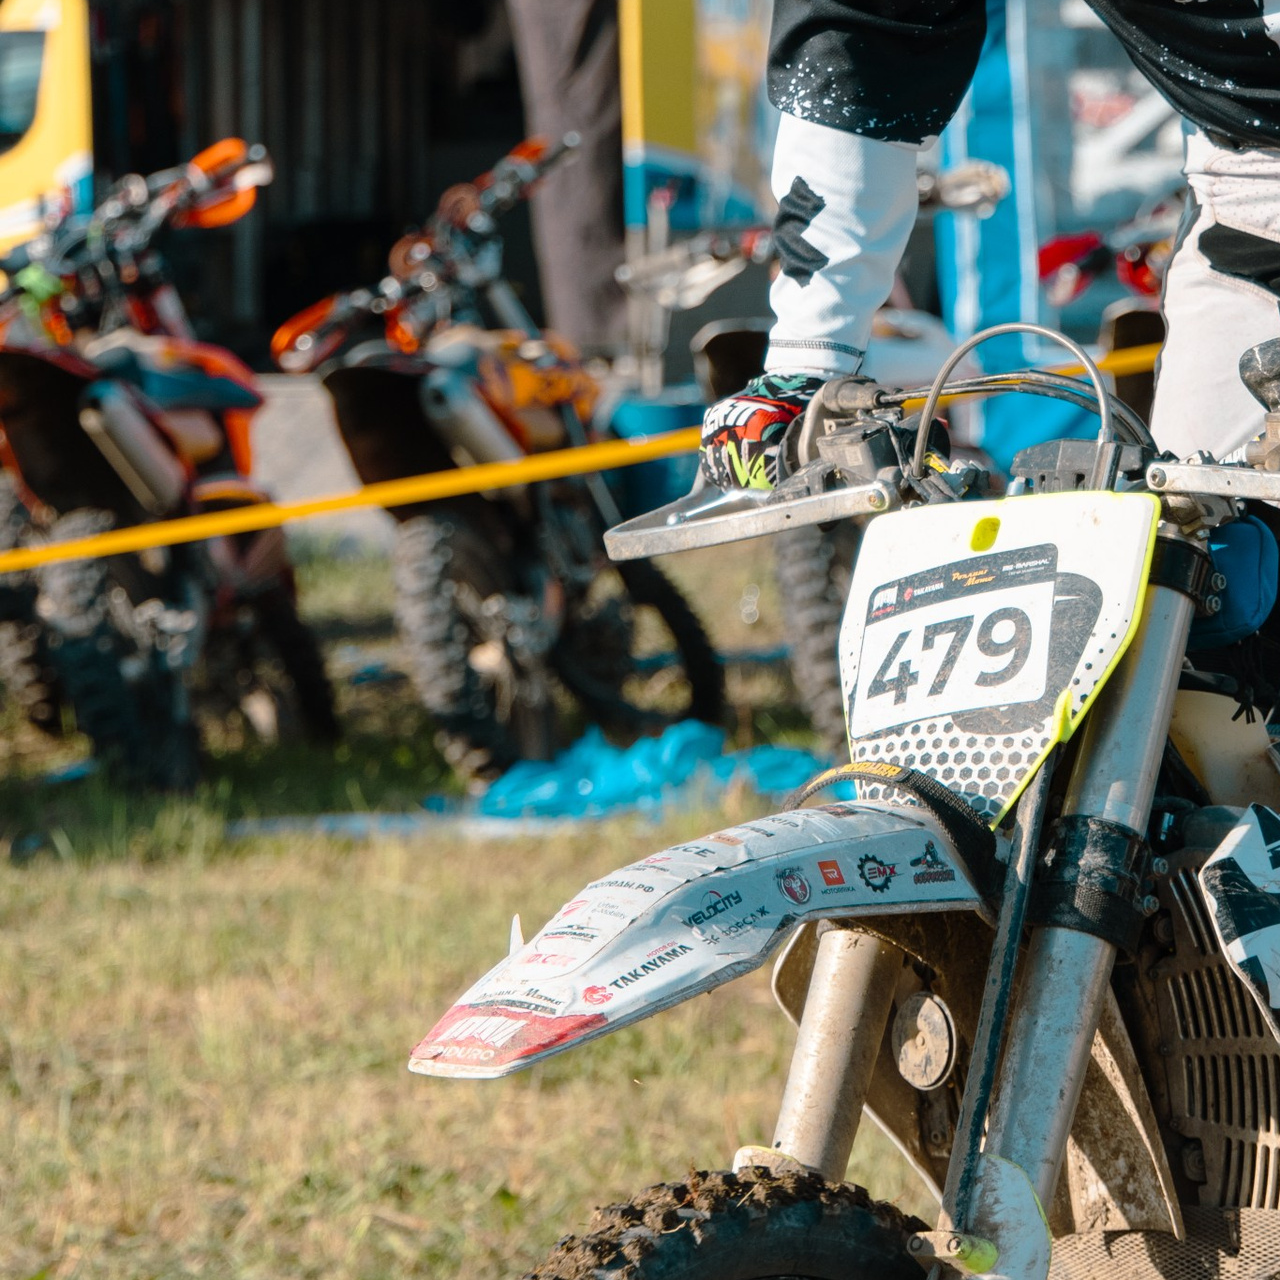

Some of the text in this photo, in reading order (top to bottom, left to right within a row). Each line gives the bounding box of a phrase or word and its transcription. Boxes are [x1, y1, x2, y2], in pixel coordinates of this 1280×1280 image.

[867, 606, 1033, 705] 479
[681, 890, 743, 928] VELOCITY
[609, 943, 694, 990] TAKAYAMA
